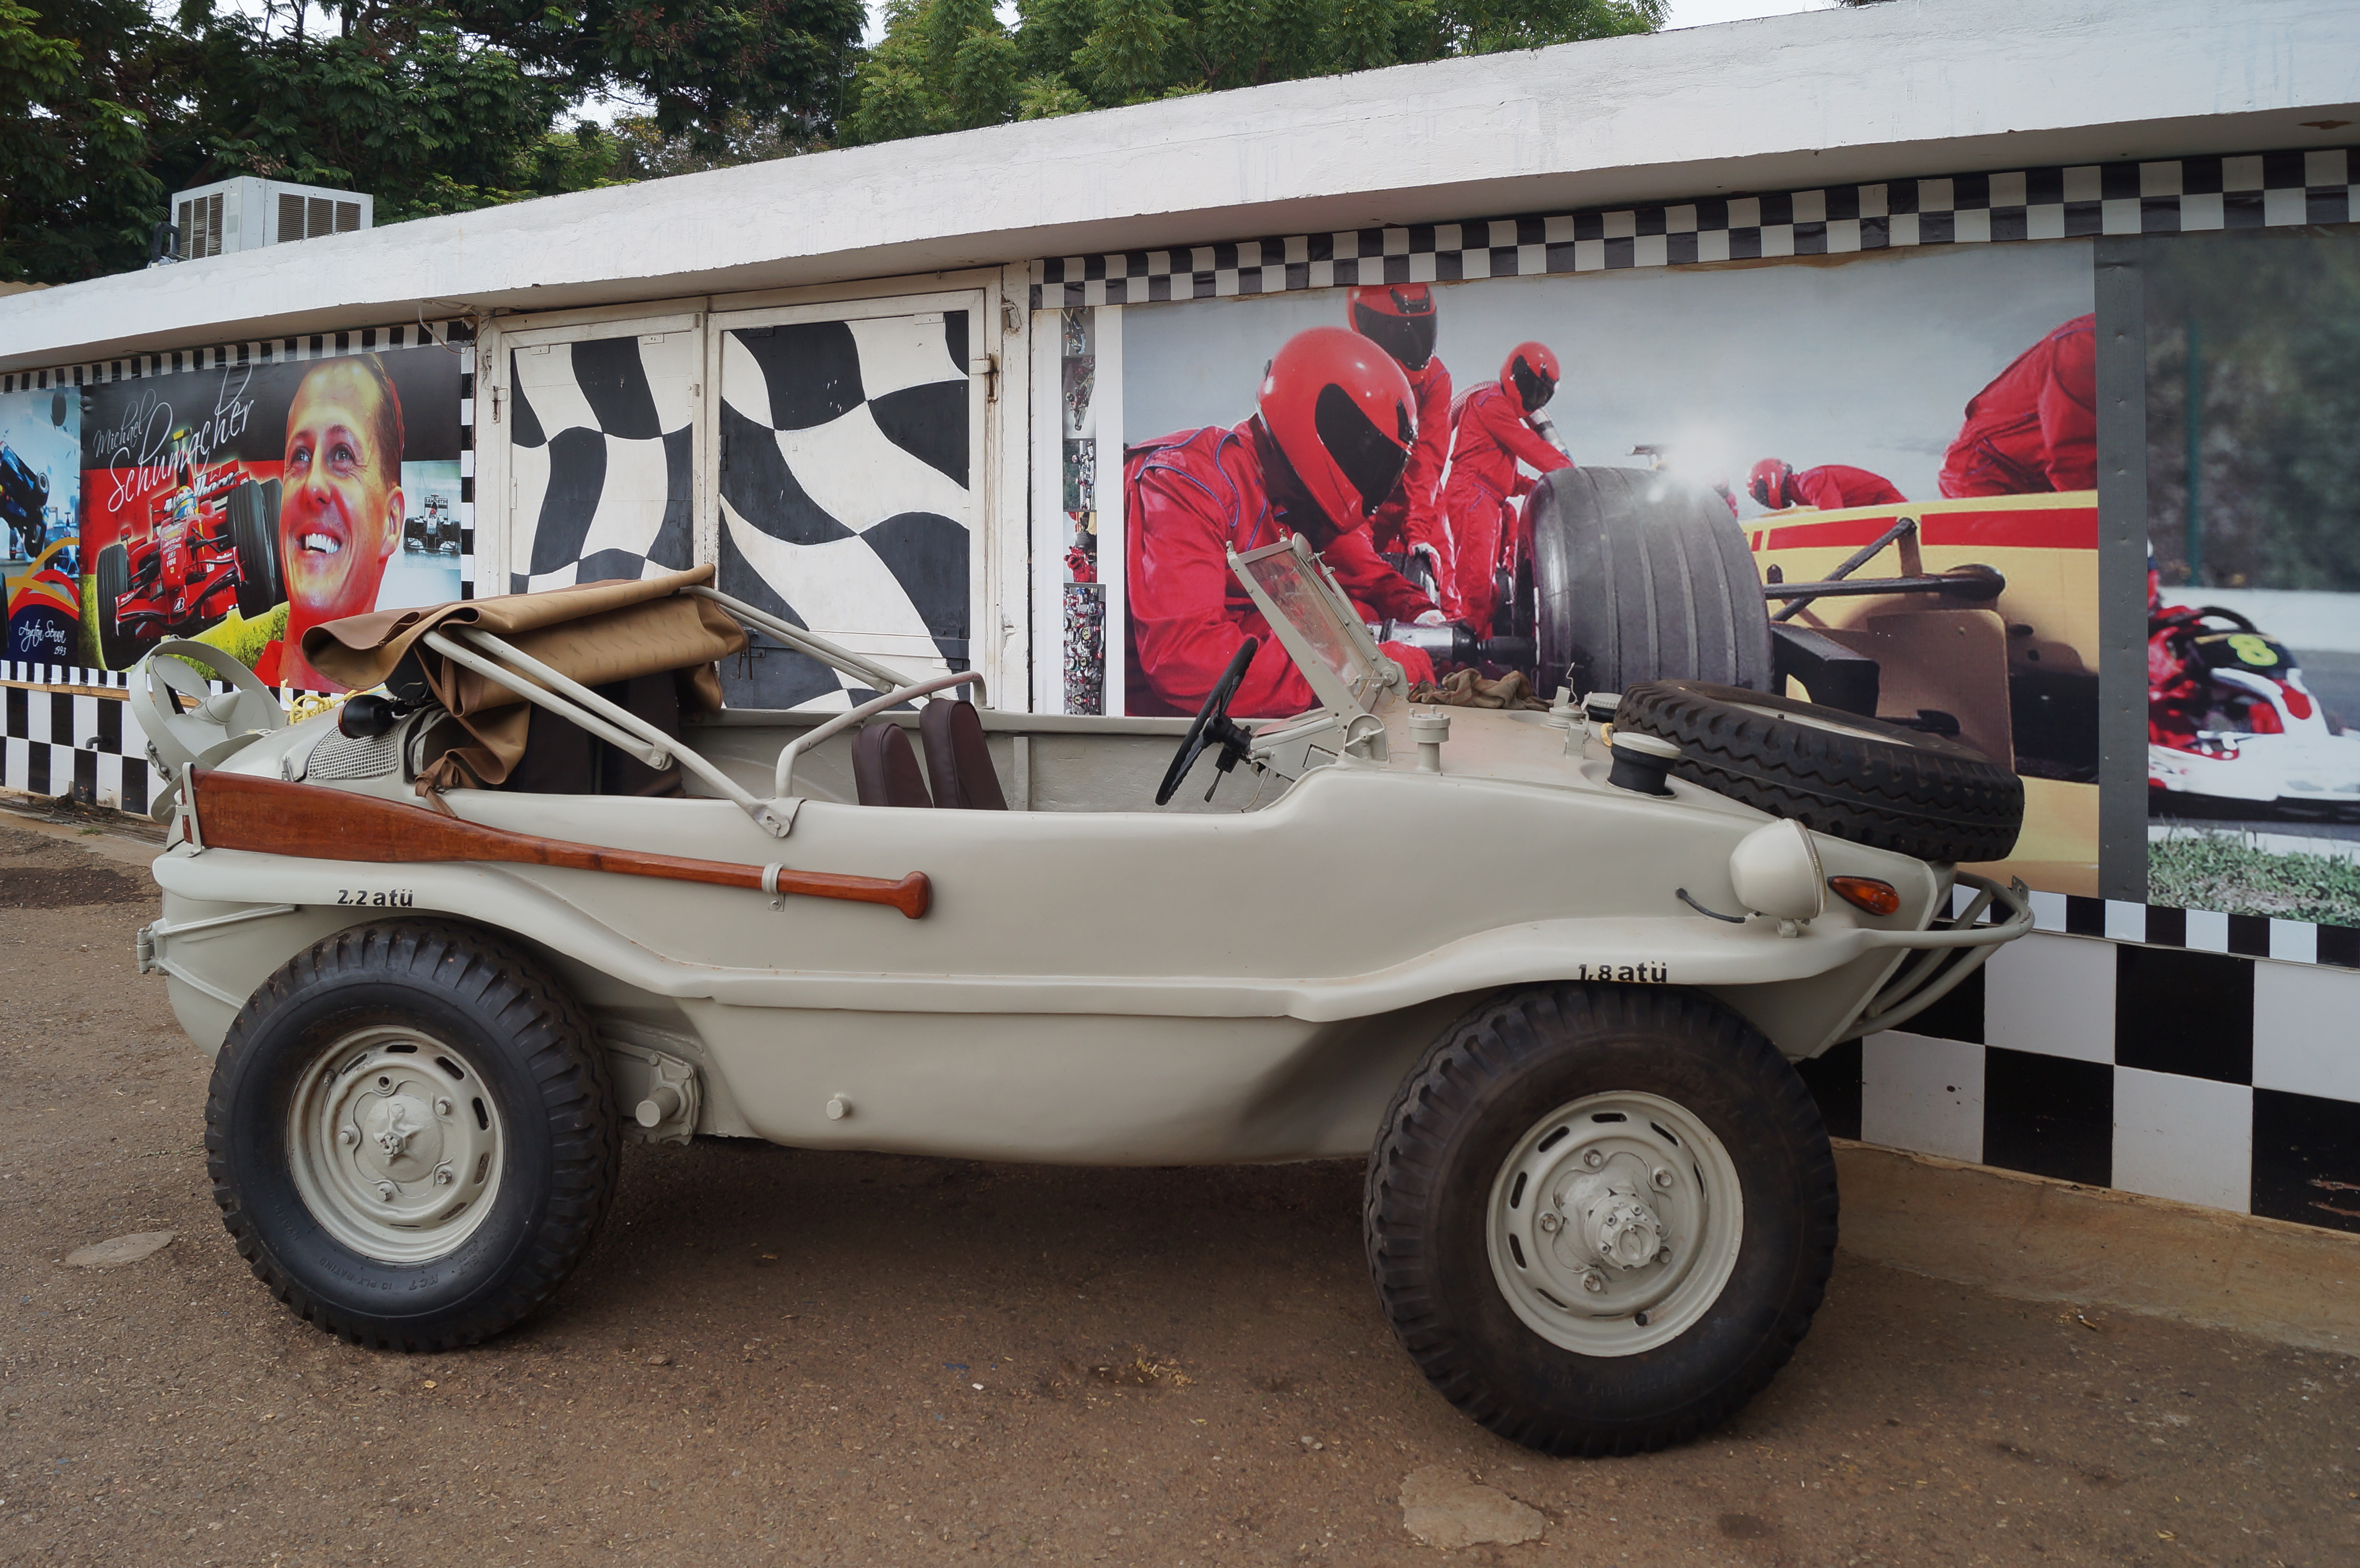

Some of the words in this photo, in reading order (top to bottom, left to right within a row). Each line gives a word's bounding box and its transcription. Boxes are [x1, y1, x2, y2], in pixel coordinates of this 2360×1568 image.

[93, 389, 156, 457] Michael
[108, 364, 254, 512] Schumacher
[167, 558, 176, 567] FIAT
[18, 619, 44, 652] Ayrton
[45, 620, 66, 643] Senna
[54, 646, 66, 656] 1993
[337, 889, 368, 905] 2,2
[373, 888, 413, 907] atü
[1578, 963, 1612, 982] 1,8
[1617, 960, 1667, 983] atü
